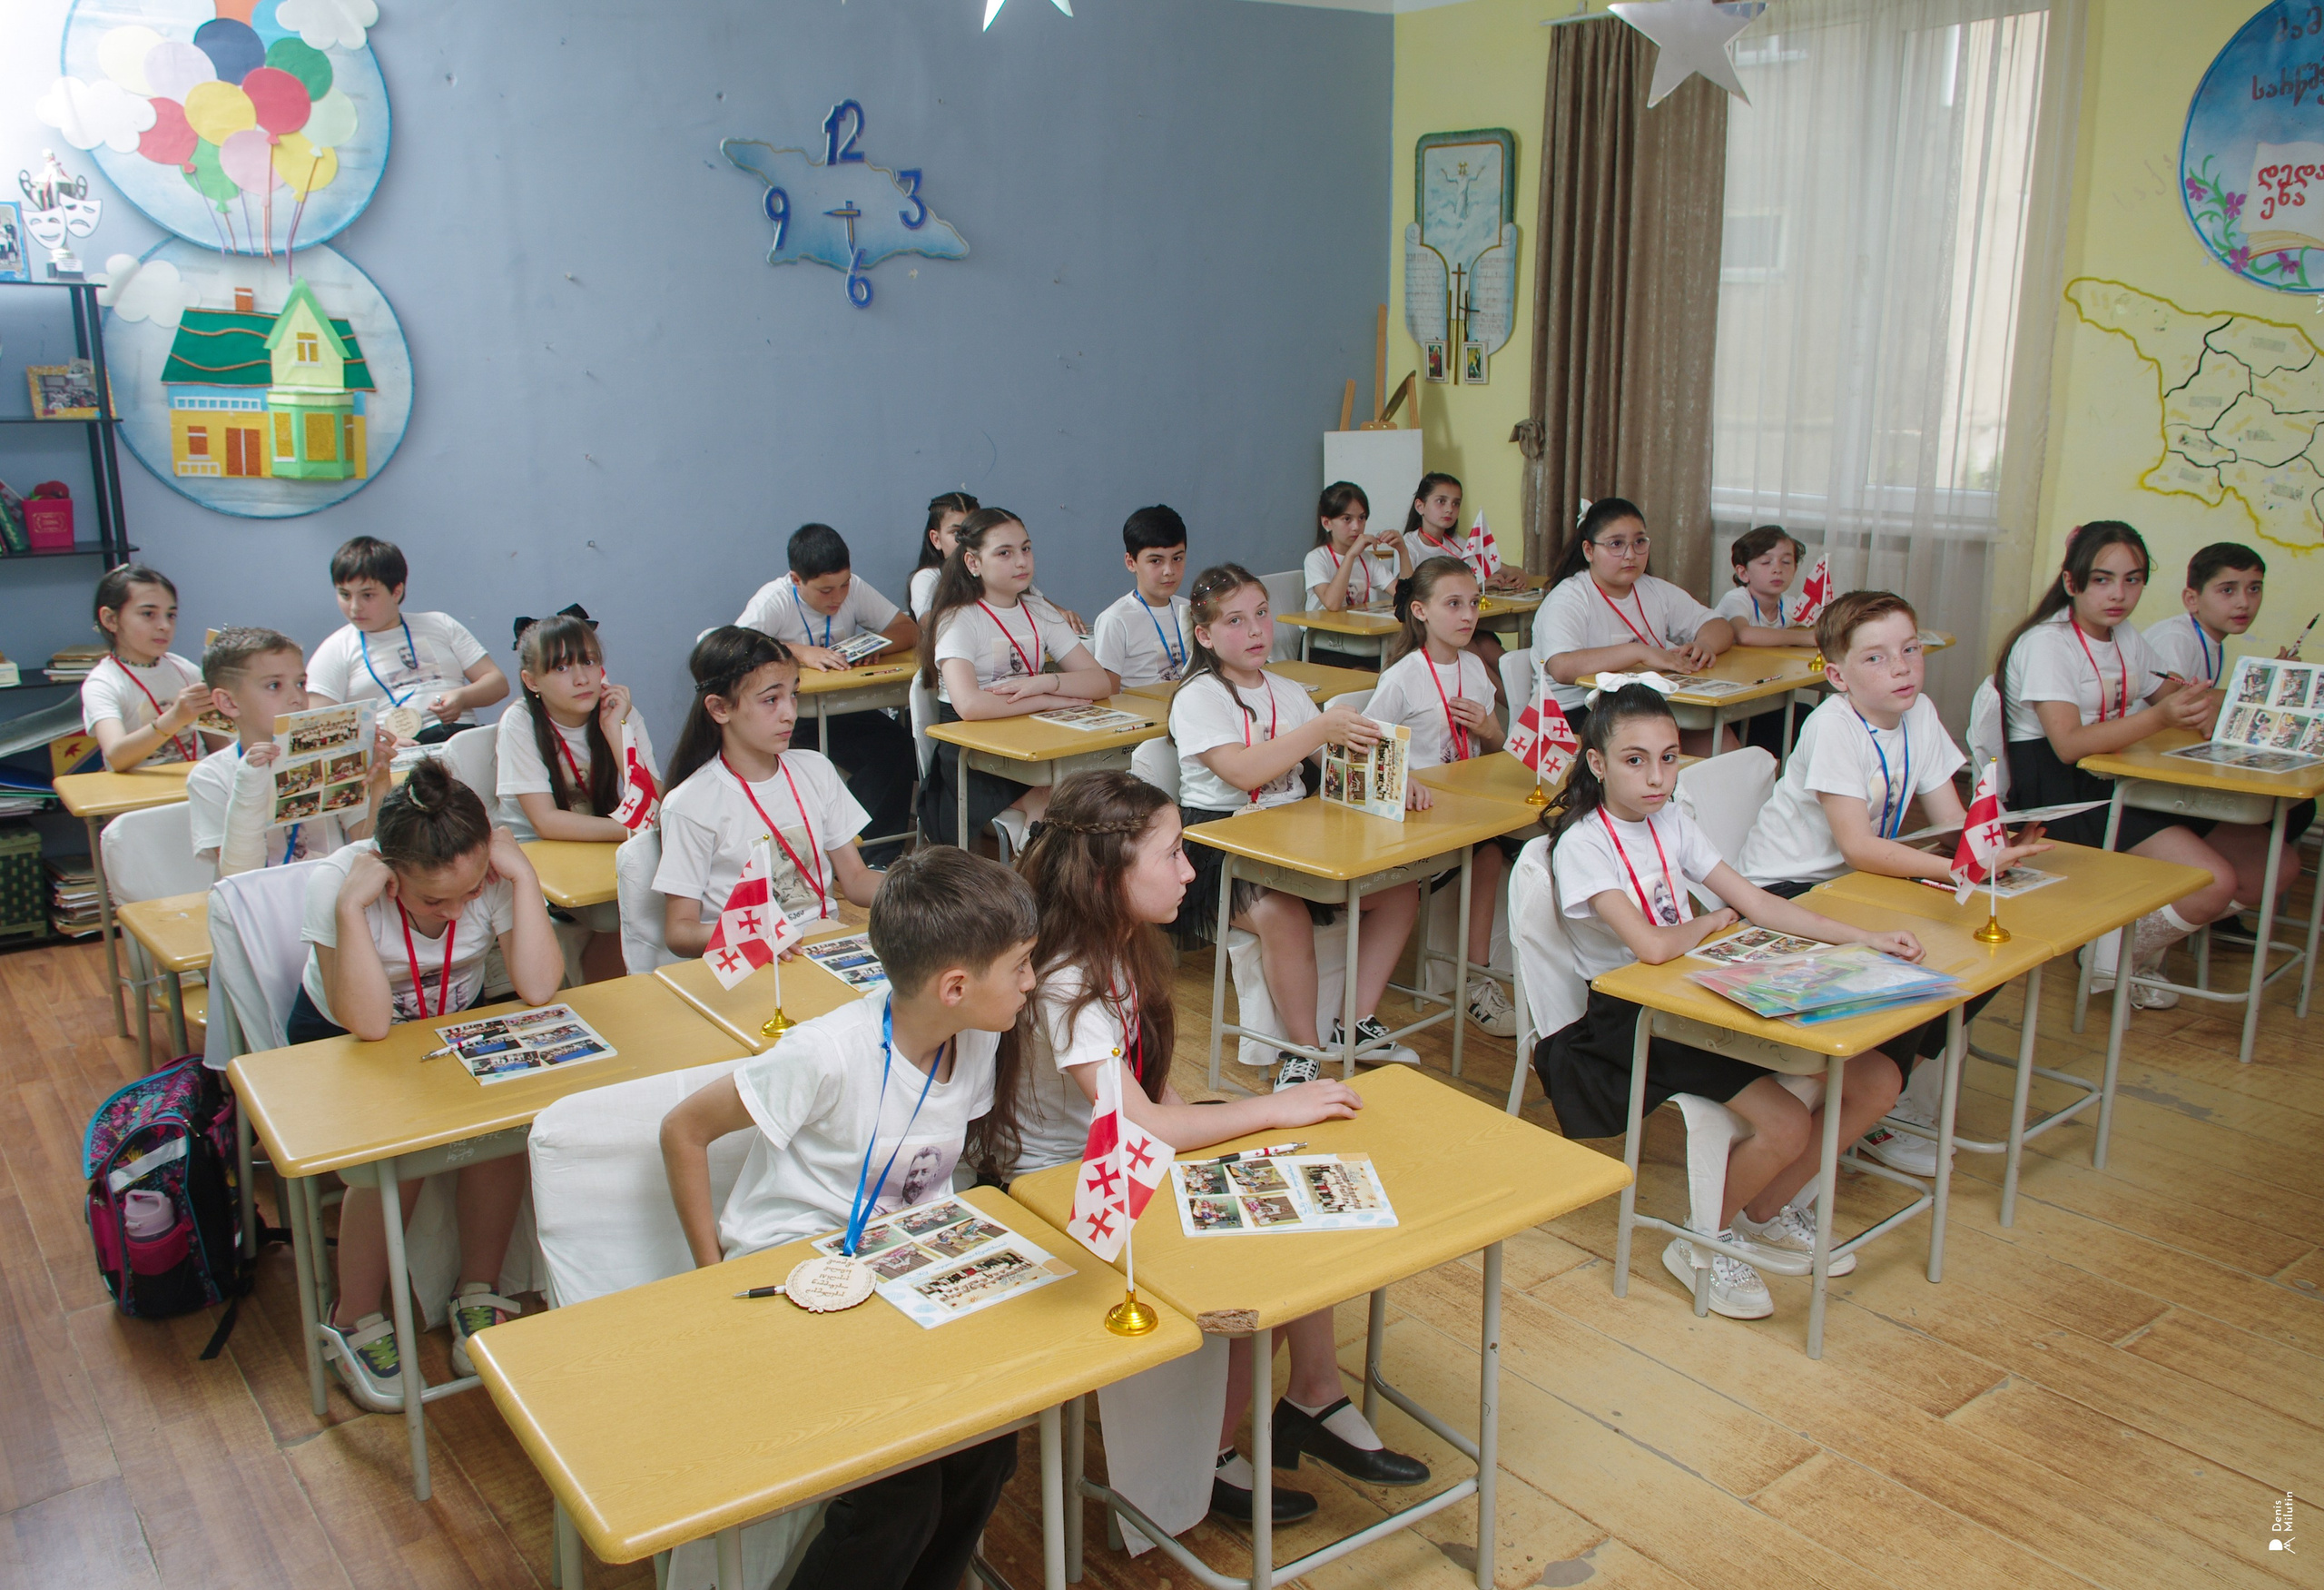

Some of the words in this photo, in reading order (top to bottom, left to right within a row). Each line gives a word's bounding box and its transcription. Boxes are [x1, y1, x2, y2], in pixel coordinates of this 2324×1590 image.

[822, 98, 865, 165] 12
[895, 168, 928, 229] 3
[2257, 163, 2324, 192] დედა
[2260, 178, 2306, 221] ენა
[763, 186, 791, 250] 9
[845, 248, 874, 309] 6
